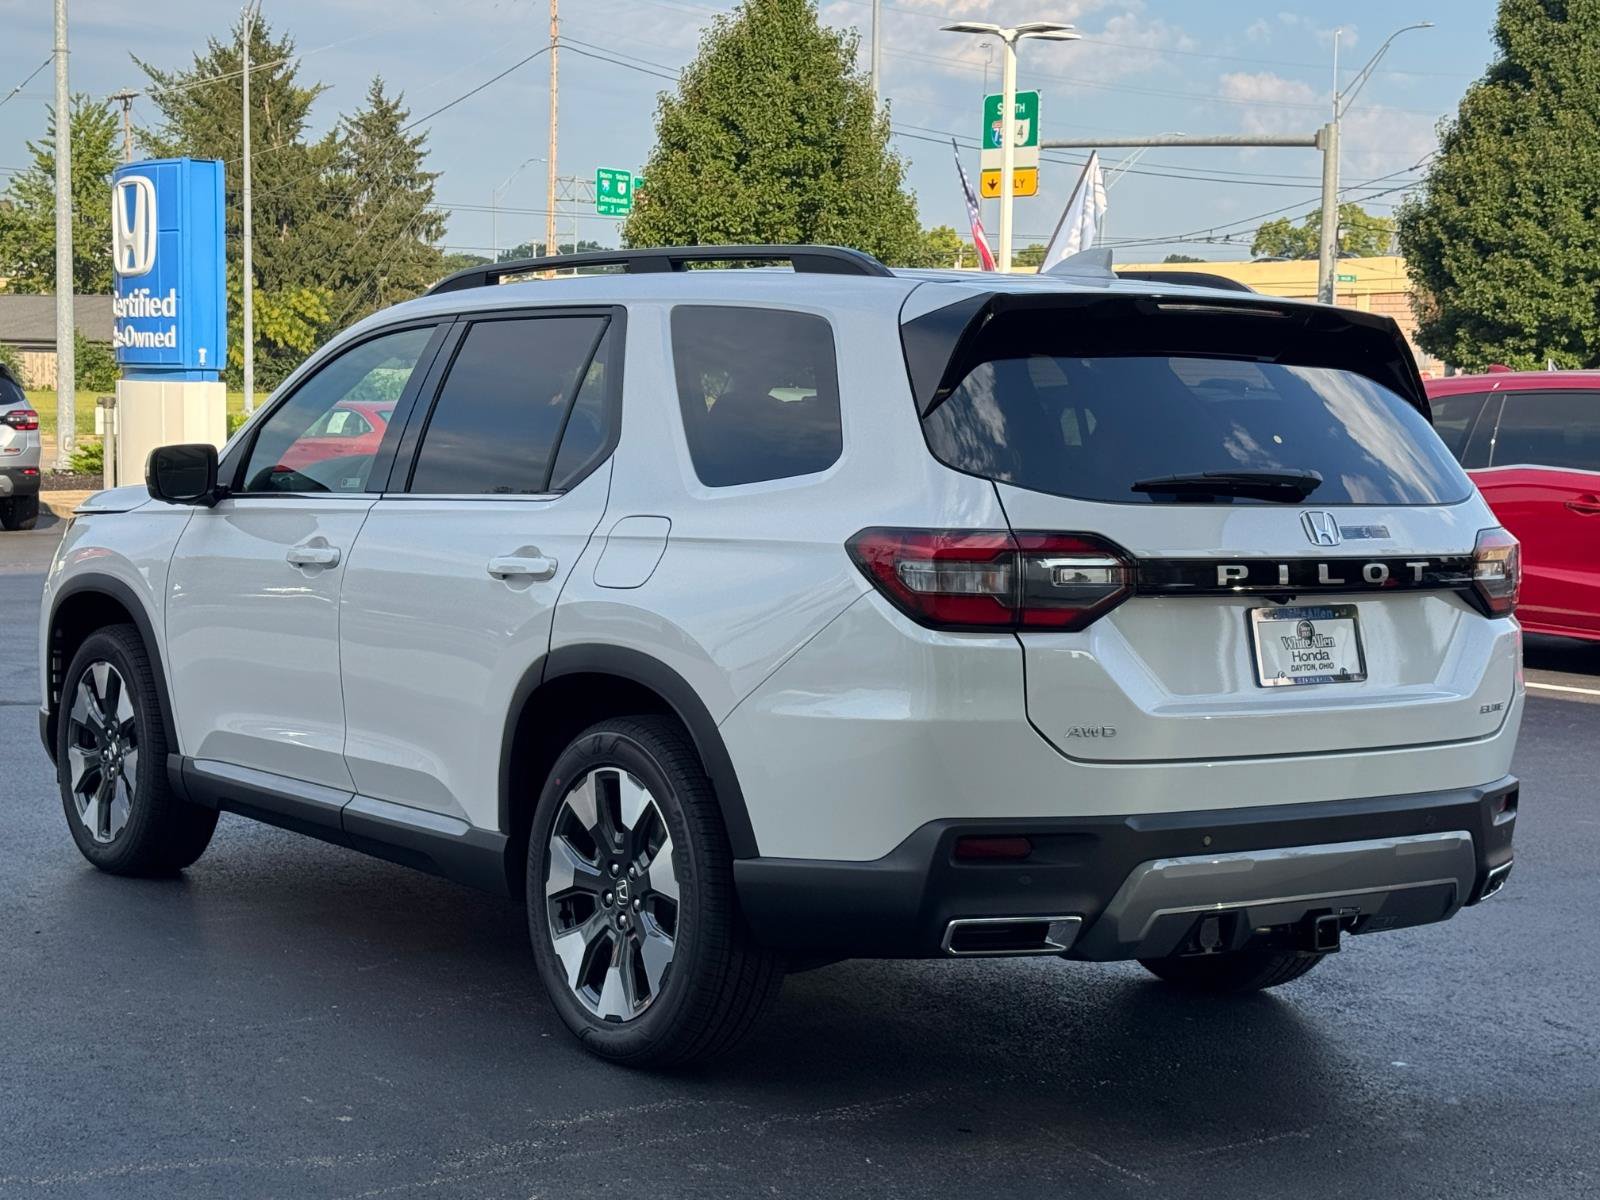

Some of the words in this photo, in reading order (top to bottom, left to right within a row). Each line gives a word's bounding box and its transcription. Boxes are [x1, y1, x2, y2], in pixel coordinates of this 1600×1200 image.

[997, 102, 1025, 115] STH
[1217, 561, 1430, 586] PILOT
[1292, 649, 1330, 662] Honda
[1319, 662, 1335, 670] OHIO
[1064, 726, 1118, 738] AWD
